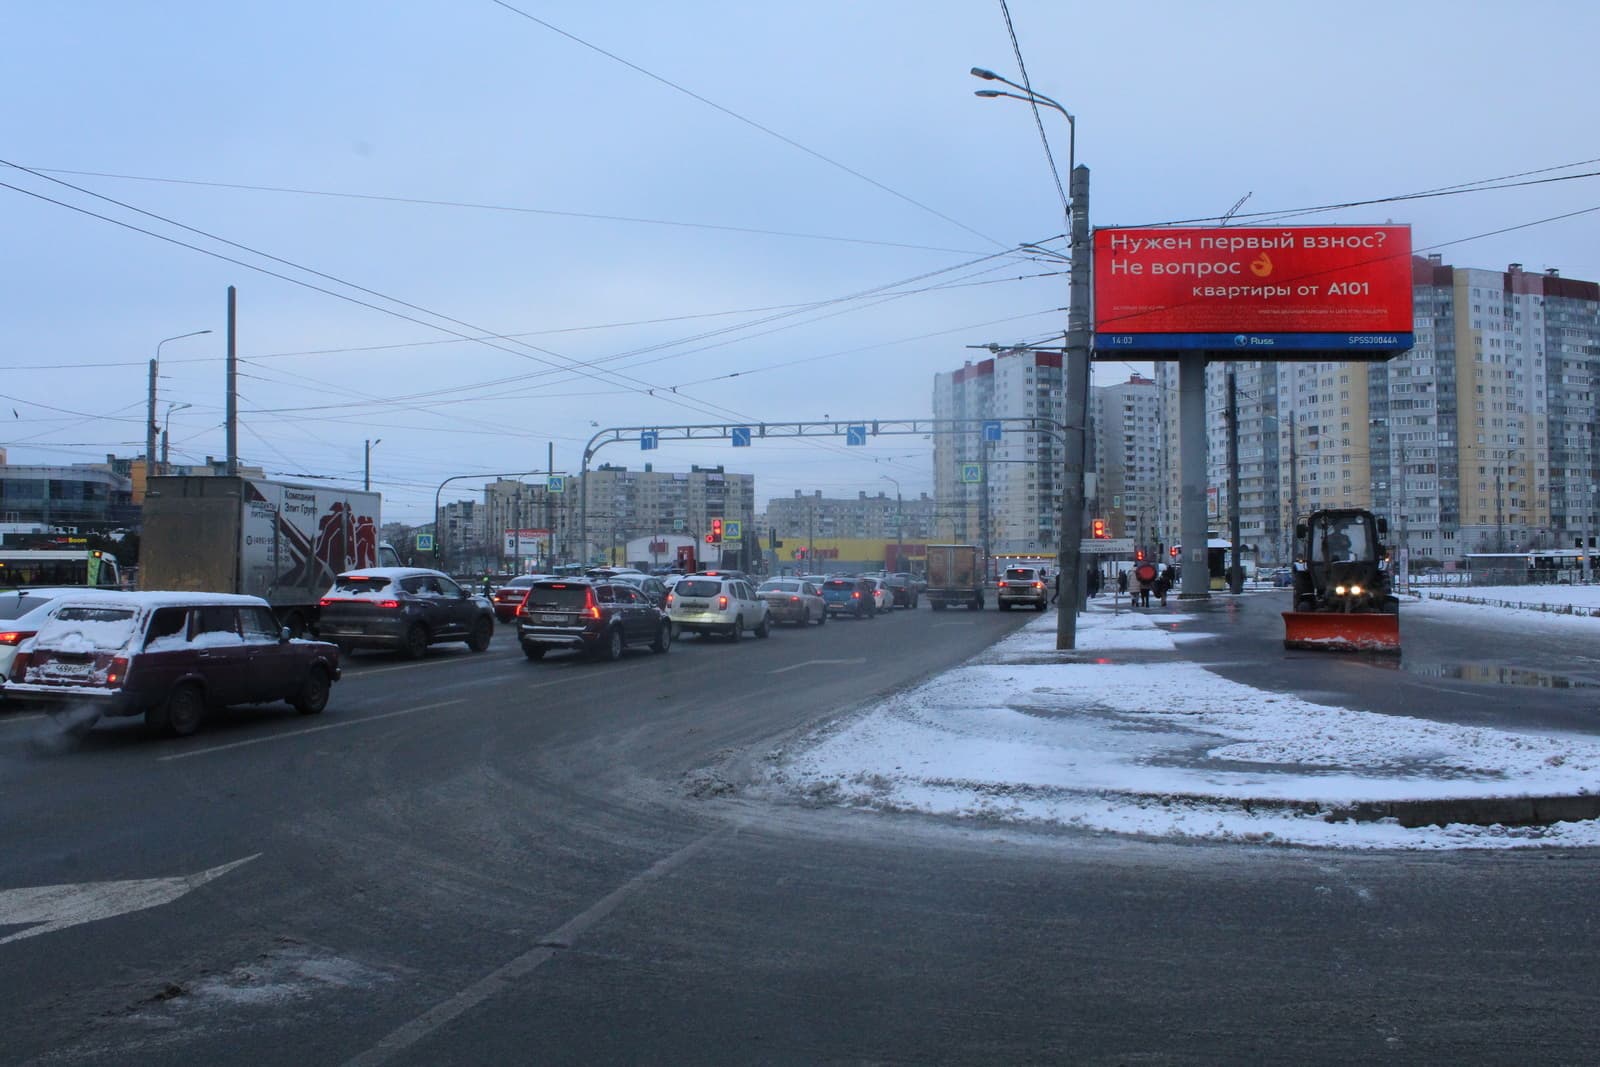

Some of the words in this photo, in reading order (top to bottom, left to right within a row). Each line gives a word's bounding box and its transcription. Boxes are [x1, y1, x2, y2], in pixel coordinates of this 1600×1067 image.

[1111, 234, 1192, 254] Нужен
[1200, 232, 1294, 253] первый
[1303, 231, 1387, 249] взнос?
[1111, 259, 1144, 275] Не
[1151, 262, 1241, 278] вопрос
[1193, 286, 1291, 299] квартиры
[1297, 286, 1319, 296] от
[1250, 337, 1274, 345] Russ
